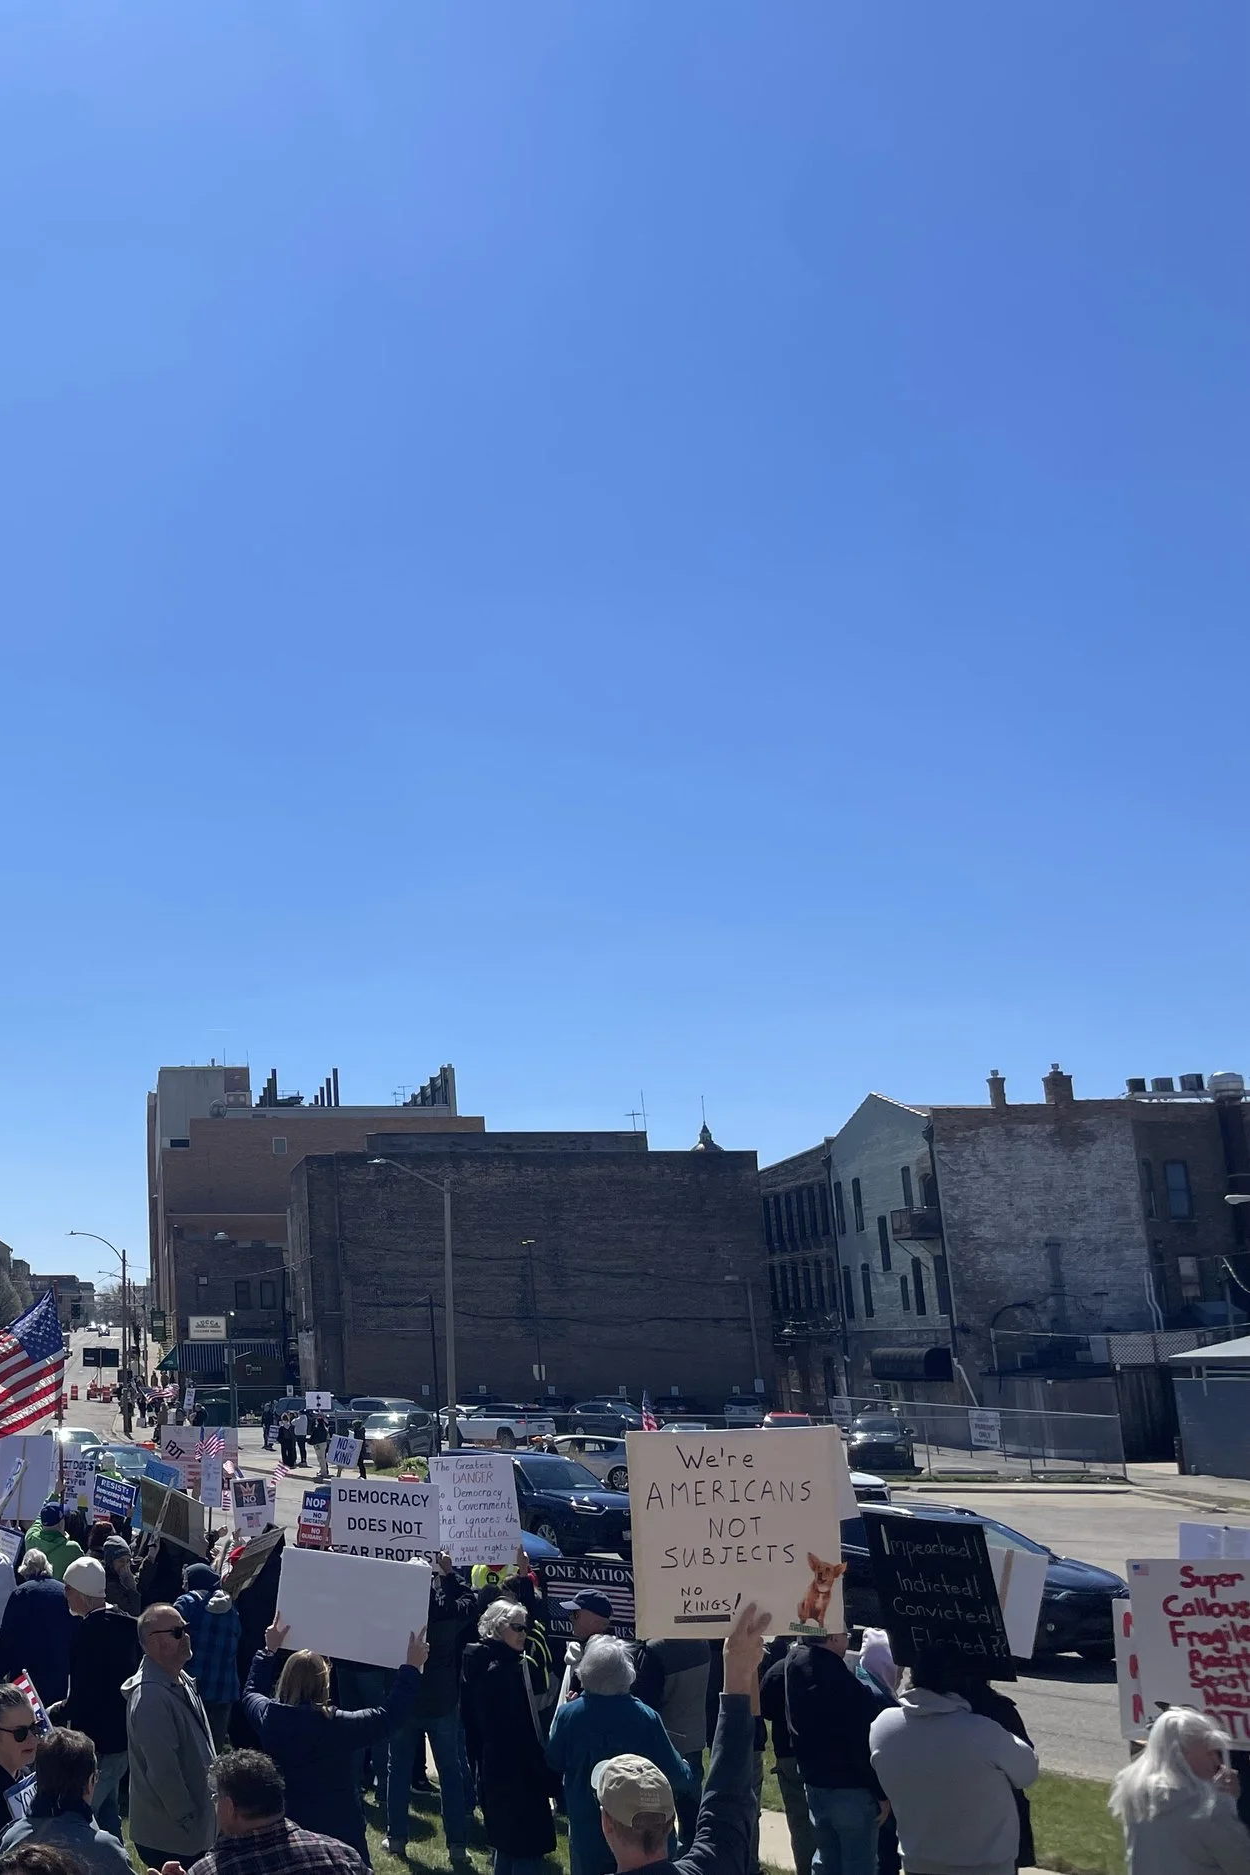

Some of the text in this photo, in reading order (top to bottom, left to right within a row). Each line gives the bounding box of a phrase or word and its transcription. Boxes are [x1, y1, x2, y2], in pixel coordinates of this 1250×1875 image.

[196, 1319, 219, 1327] LUCCA
[336, 1437, 349, 1451] NO
[676, 1444, 754, 1470] We're
[73, 1460, 95, 1471] DOES
[434, 1458, 494, 1472] The Greatest
[452, 1470, 494, 1485] DANGER
[96, 1486, 121, 1501] Democracy
[101, 1479, 129, 1495] RESIST:
[453, 1486, 503, 1500] Democracy
[243, 1495, 257, 1503] NO
[305, 1496, 327, 1509] NOP
[338, 1489, 430, 1508] DEMOCRACY
[646, 1479, 812, 1511] AMERICANS
[446, 1504, 453, 1512] a
[457, 1496, 513, 1512] Government
[312, 1511, 323, 1519] NO
[441, 1514, 456, 1525] hat
[347, 1517, 423, 1535] DOES NOT
[448, 1525, 509, 1539] Constitution
[709, 1516, 762, 1539] NOT
[484, 1543, 508, 1553] rights
[661, 1543, 796, 1569] SUBJECTS
[545, 1564, 634, 1583] ONE NATION
[895, 1570, 982, 1600] Indicted!
[1180, 1565, 1244, 1598] Super
[680, 1586, 703, 1597] NO
[683, 1592, 742, 1616] KINGS!
[1162, 1595, 1250, 1618] Callous
[550, 1620, 635, 1639] UND RES
